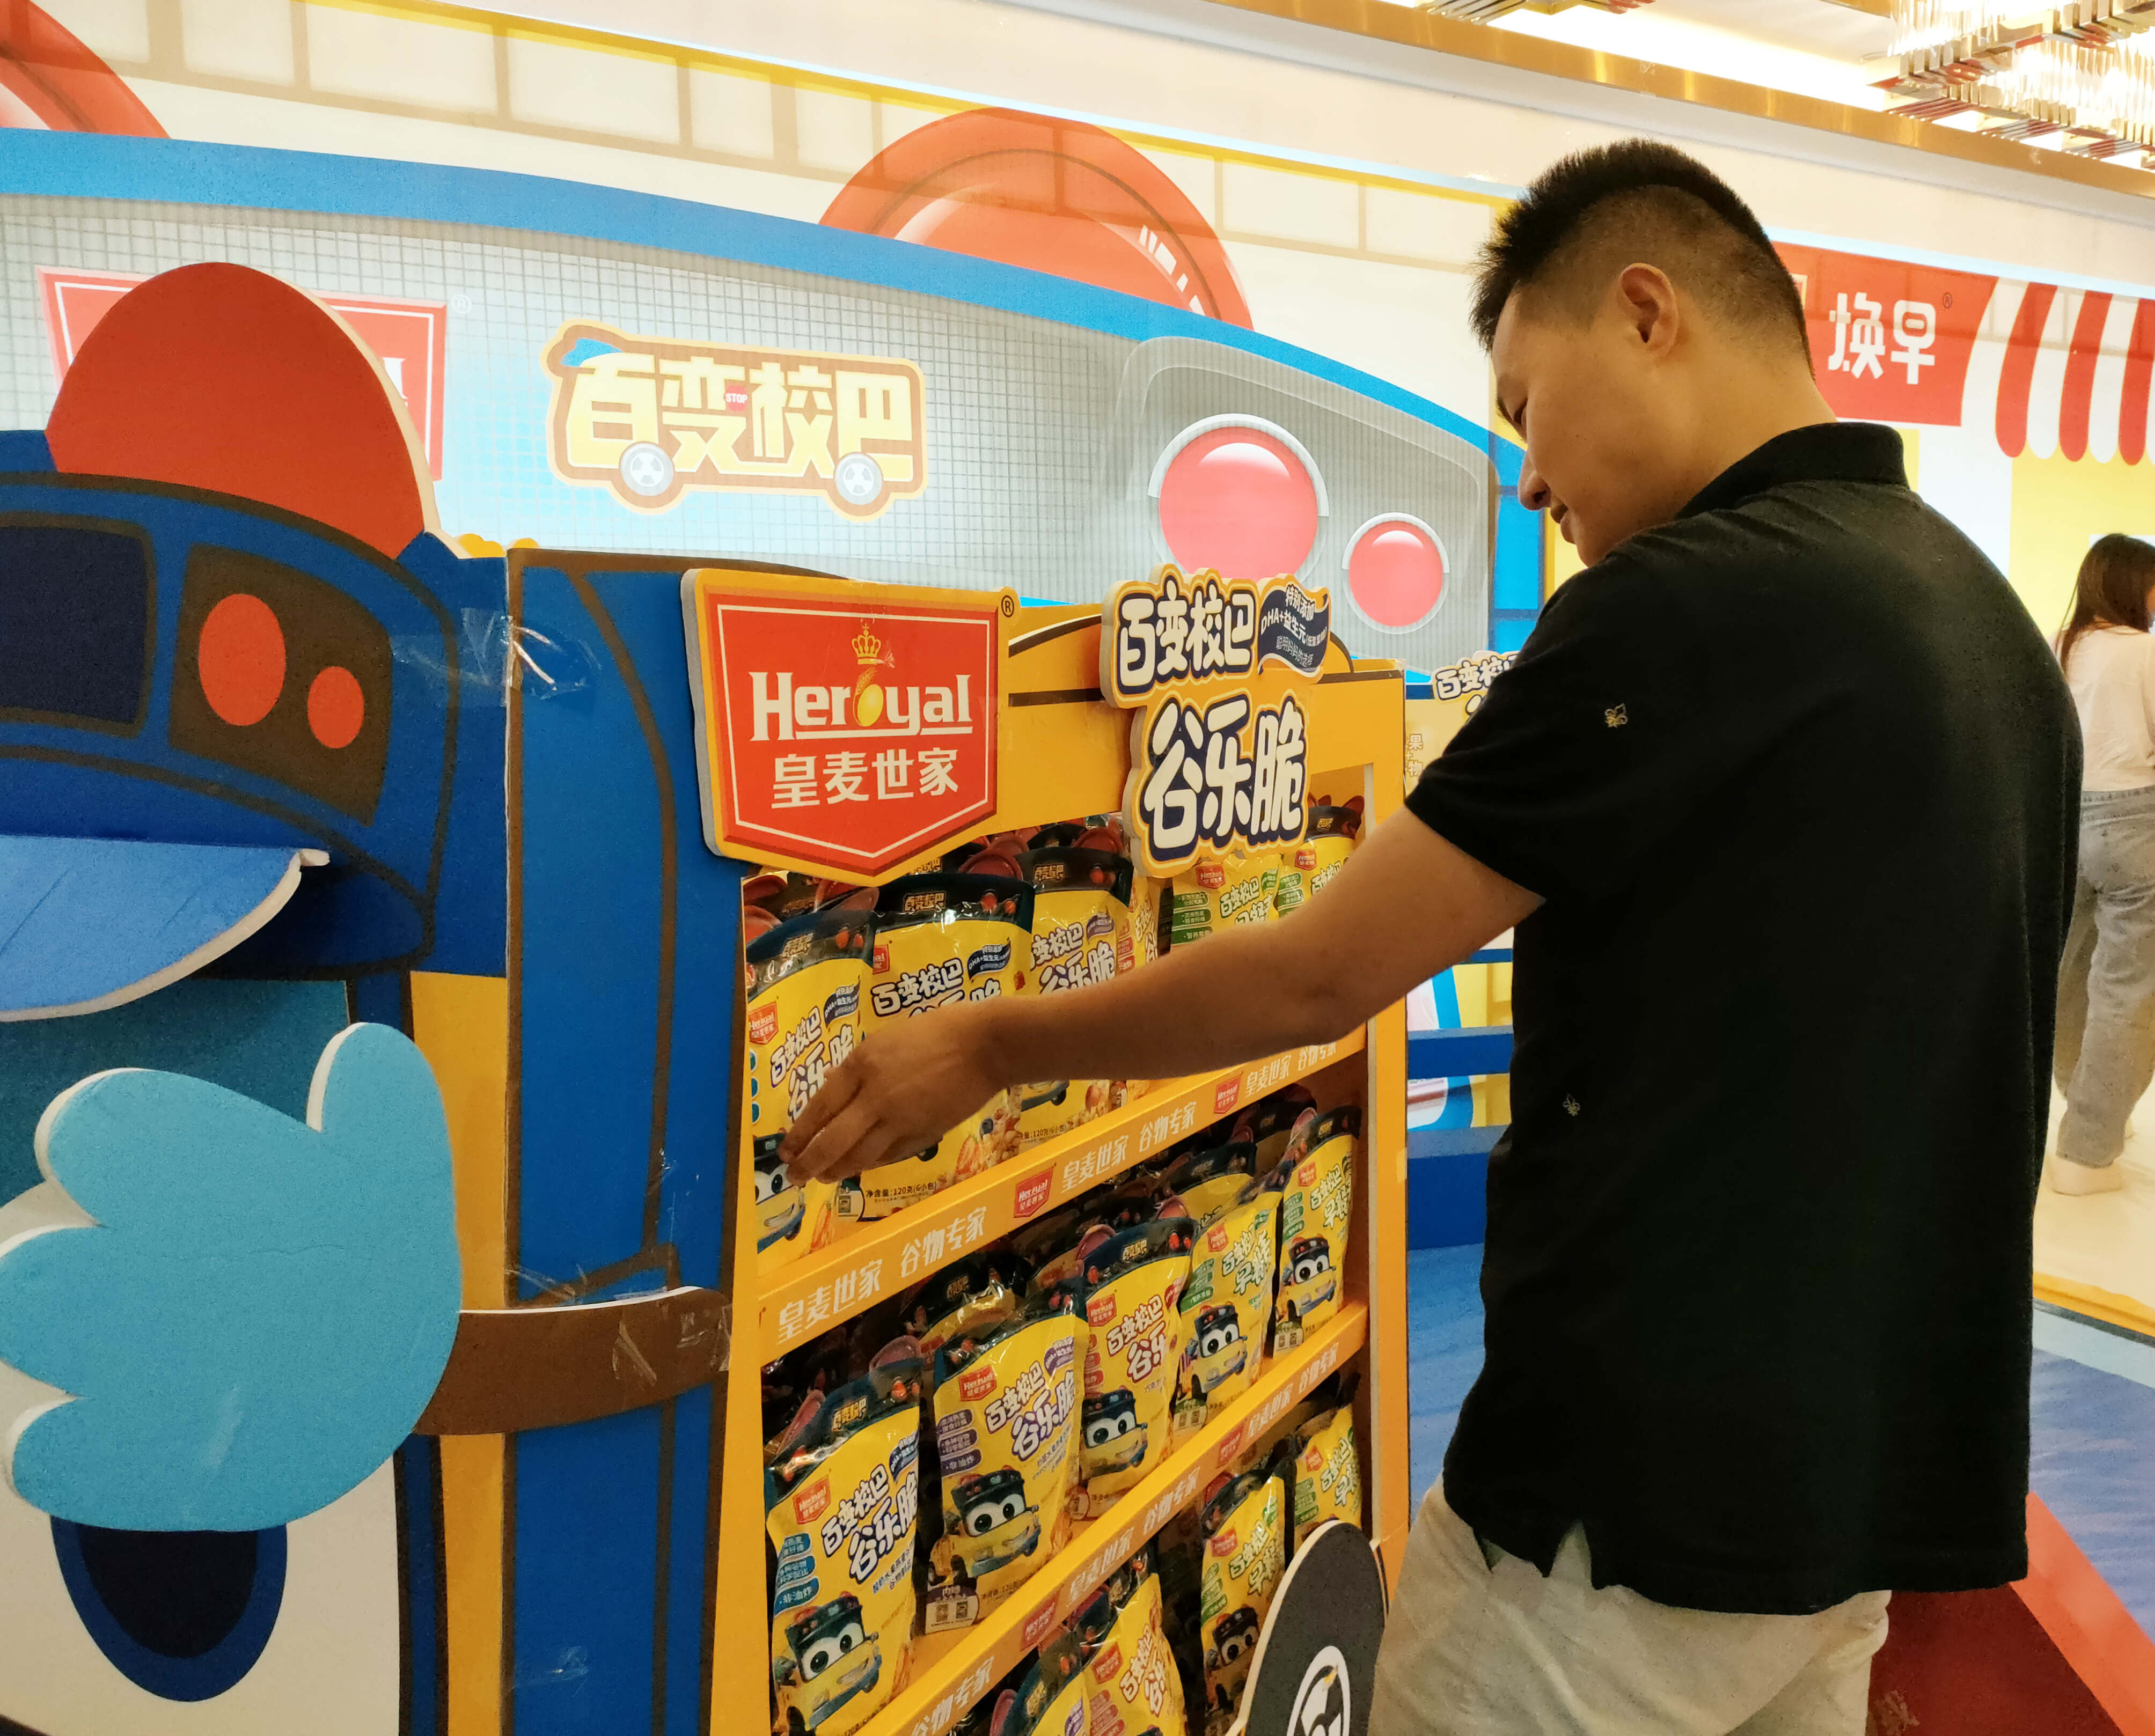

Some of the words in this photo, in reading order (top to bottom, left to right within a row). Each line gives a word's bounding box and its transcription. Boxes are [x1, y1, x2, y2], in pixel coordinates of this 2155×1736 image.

[1828, 292, 1936, 384] 焕早
[566, 353, 914, 484] 百变校巴
[725, 393, 748, 404] STOP
[1119, 579, 1254, 687] 百变校巴
[1285, 584, 1315, 621] 特别添加
[749, 671, 973, 741] Heroyal
[1144, 700, 1304, 849] 谷乐脆
[1405, 733, 1424, 751] 果
[771, 747, 959, 809] 皇麦世家
[1220, 877, 1259, 918] 百变校巴
[871, 958, 964, 1017] 百变校巴
[771, 1005, 822, 1088] 百变校巴
[1245, 1055, 1292, 1099] 皇麦世家
[1139, 1101, 1197, 1153] 谷物专家
[1061, 1135, 1128, 1194] 皇麦世家
[900, 1206, 986, 1278] 谷物专家
[778, 1258, 883, 1344] 皇麦世家
[1106, 1294, 1163, 1357] 百变校巴
[985, 1360, 1045, 1435] 百变校巴
[822, 1463, 889, 1557] 百变校巴
